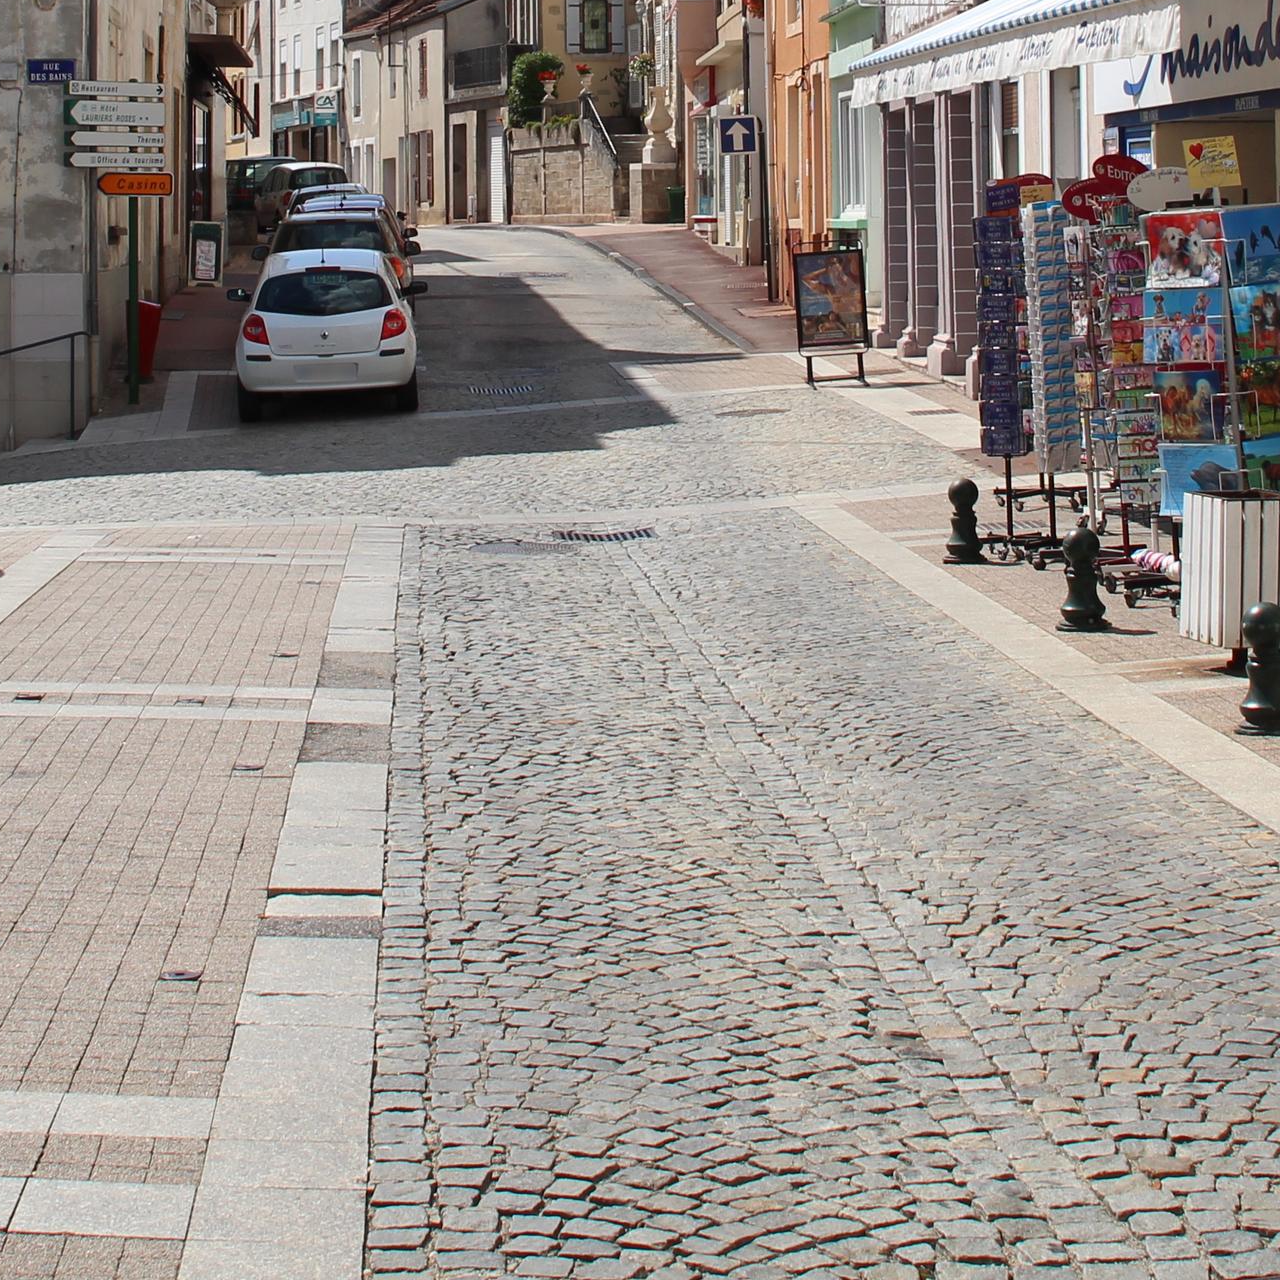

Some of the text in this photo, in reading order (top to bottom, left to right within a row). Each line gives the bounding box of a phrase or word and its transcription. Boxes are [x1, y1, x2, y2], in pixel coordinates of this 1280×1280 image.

[42, 63, 60, 71] RUE
[30, 72, 73, 81] DES BAINS
[81, 85, 119, 93] Restaurant
[316, 95, 334, 107] CA
[100, 104, 119, 112] Hôtel
[81, 113, 136, 123] LAURIERS ROSES
[137, 136, 164, 144] Thermes
[97, 155, 164, 164] Office du tourisme
[116, 178, 166, 189] Casino
